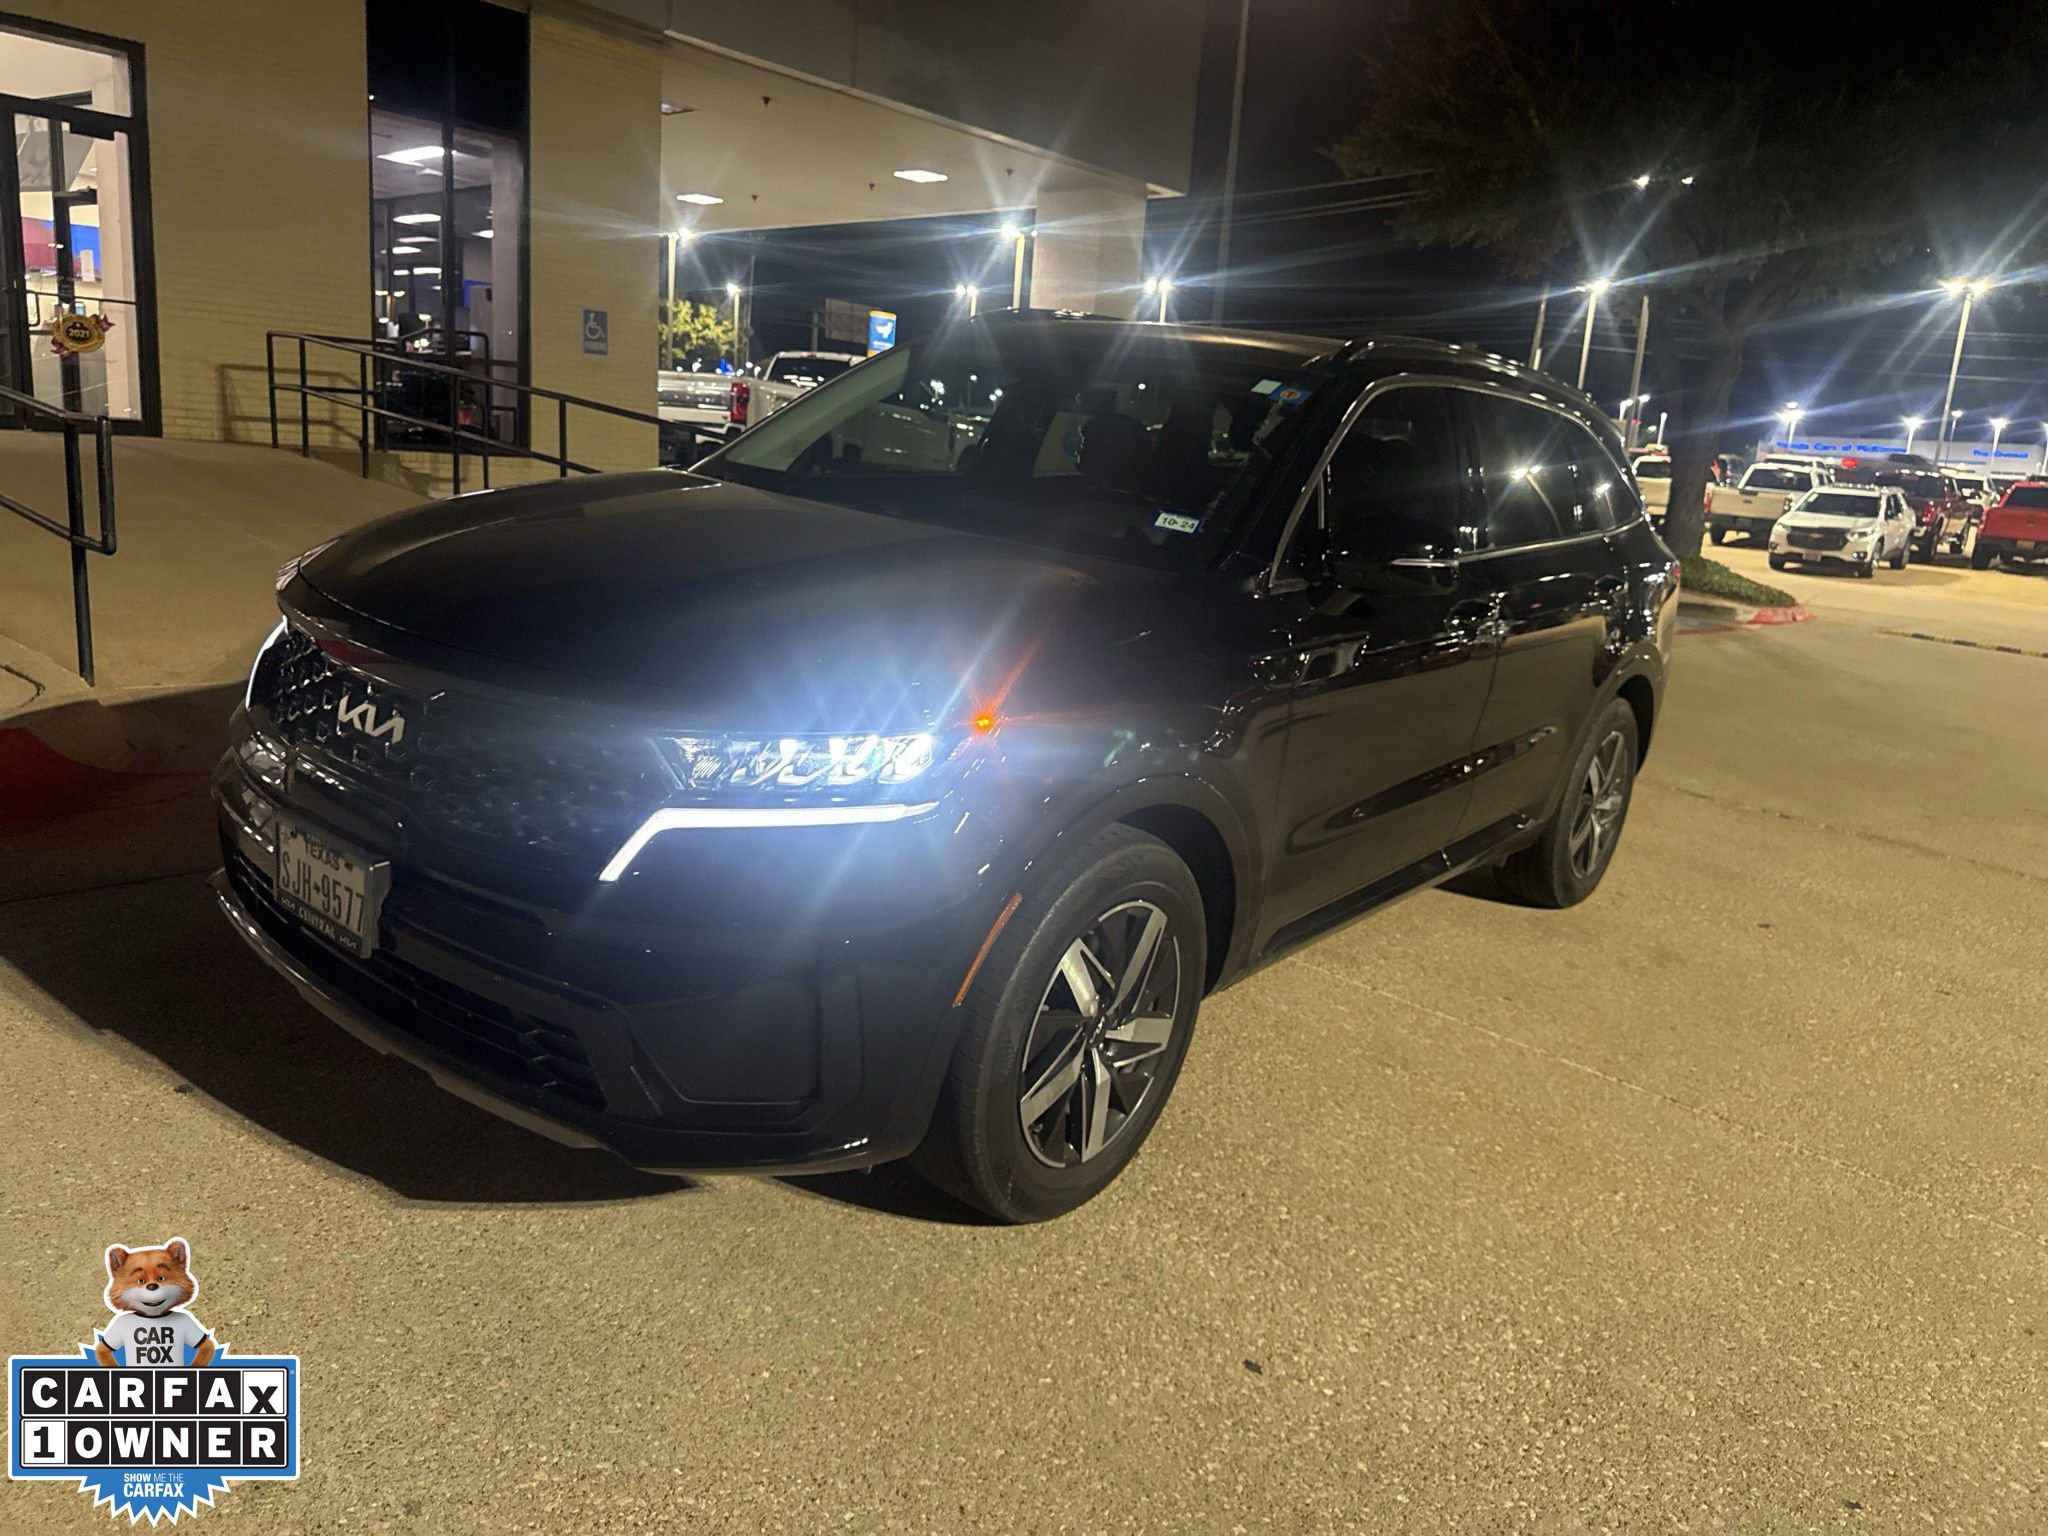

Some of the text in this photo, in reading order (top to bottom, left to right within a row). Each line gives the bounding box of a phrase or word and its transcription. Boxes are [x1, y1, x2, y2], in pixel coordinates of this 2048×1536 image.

[68, 328, 89, 338] 2021
[338, 694, 405, 745] KIA
[304, 836, 340, 871] TEXAS
